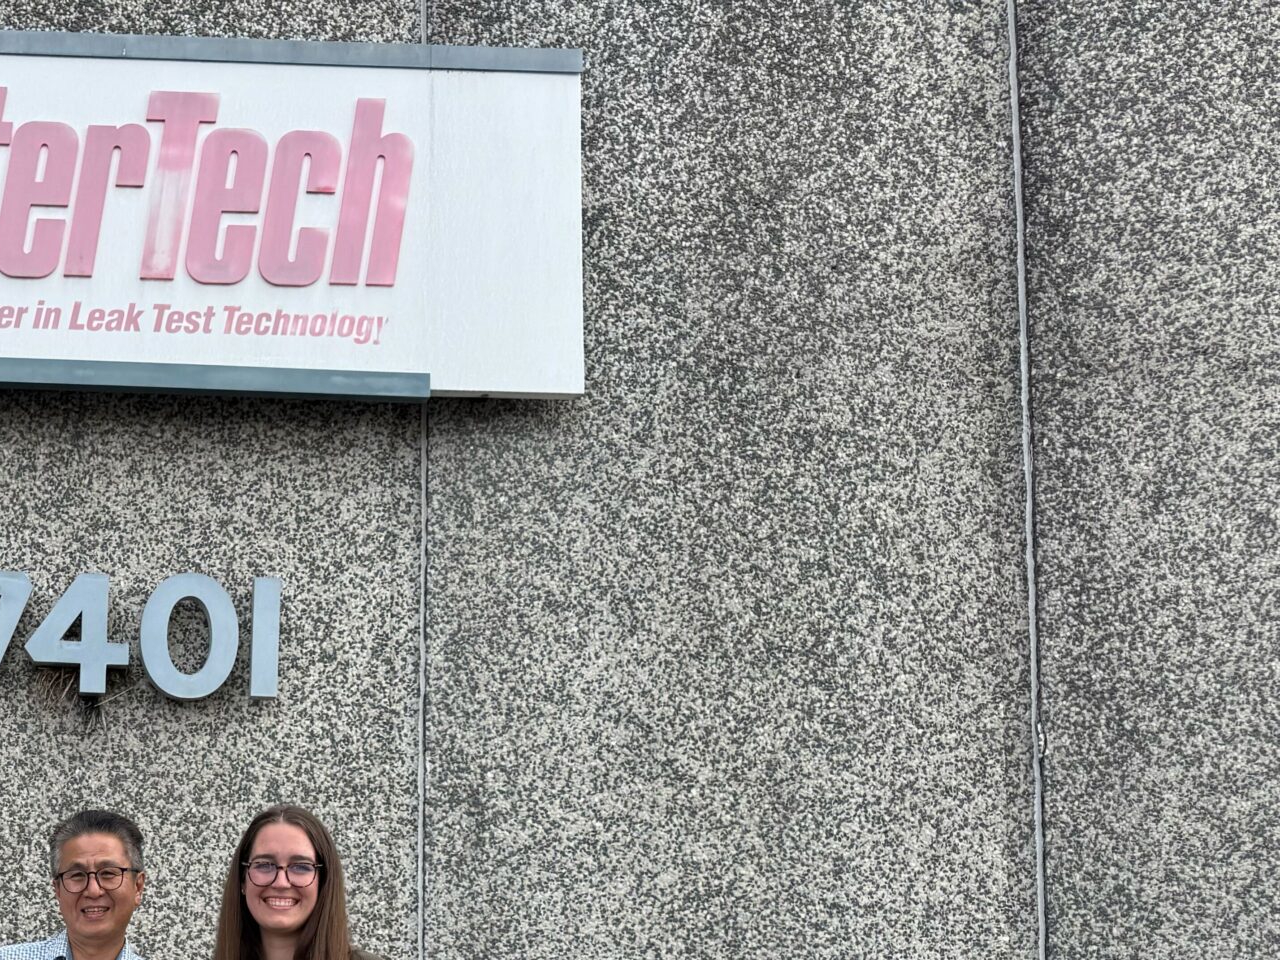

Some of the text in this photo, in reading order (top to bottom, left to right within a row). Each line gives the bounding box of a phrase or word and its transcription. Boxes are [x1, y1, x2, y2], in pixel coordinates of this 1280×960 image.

[32, 300, 62, 330] in
[68, 301, 145, 332] Leak
[152, 303, 216, 334] Test
[223, 305, 389, 345] Technology
